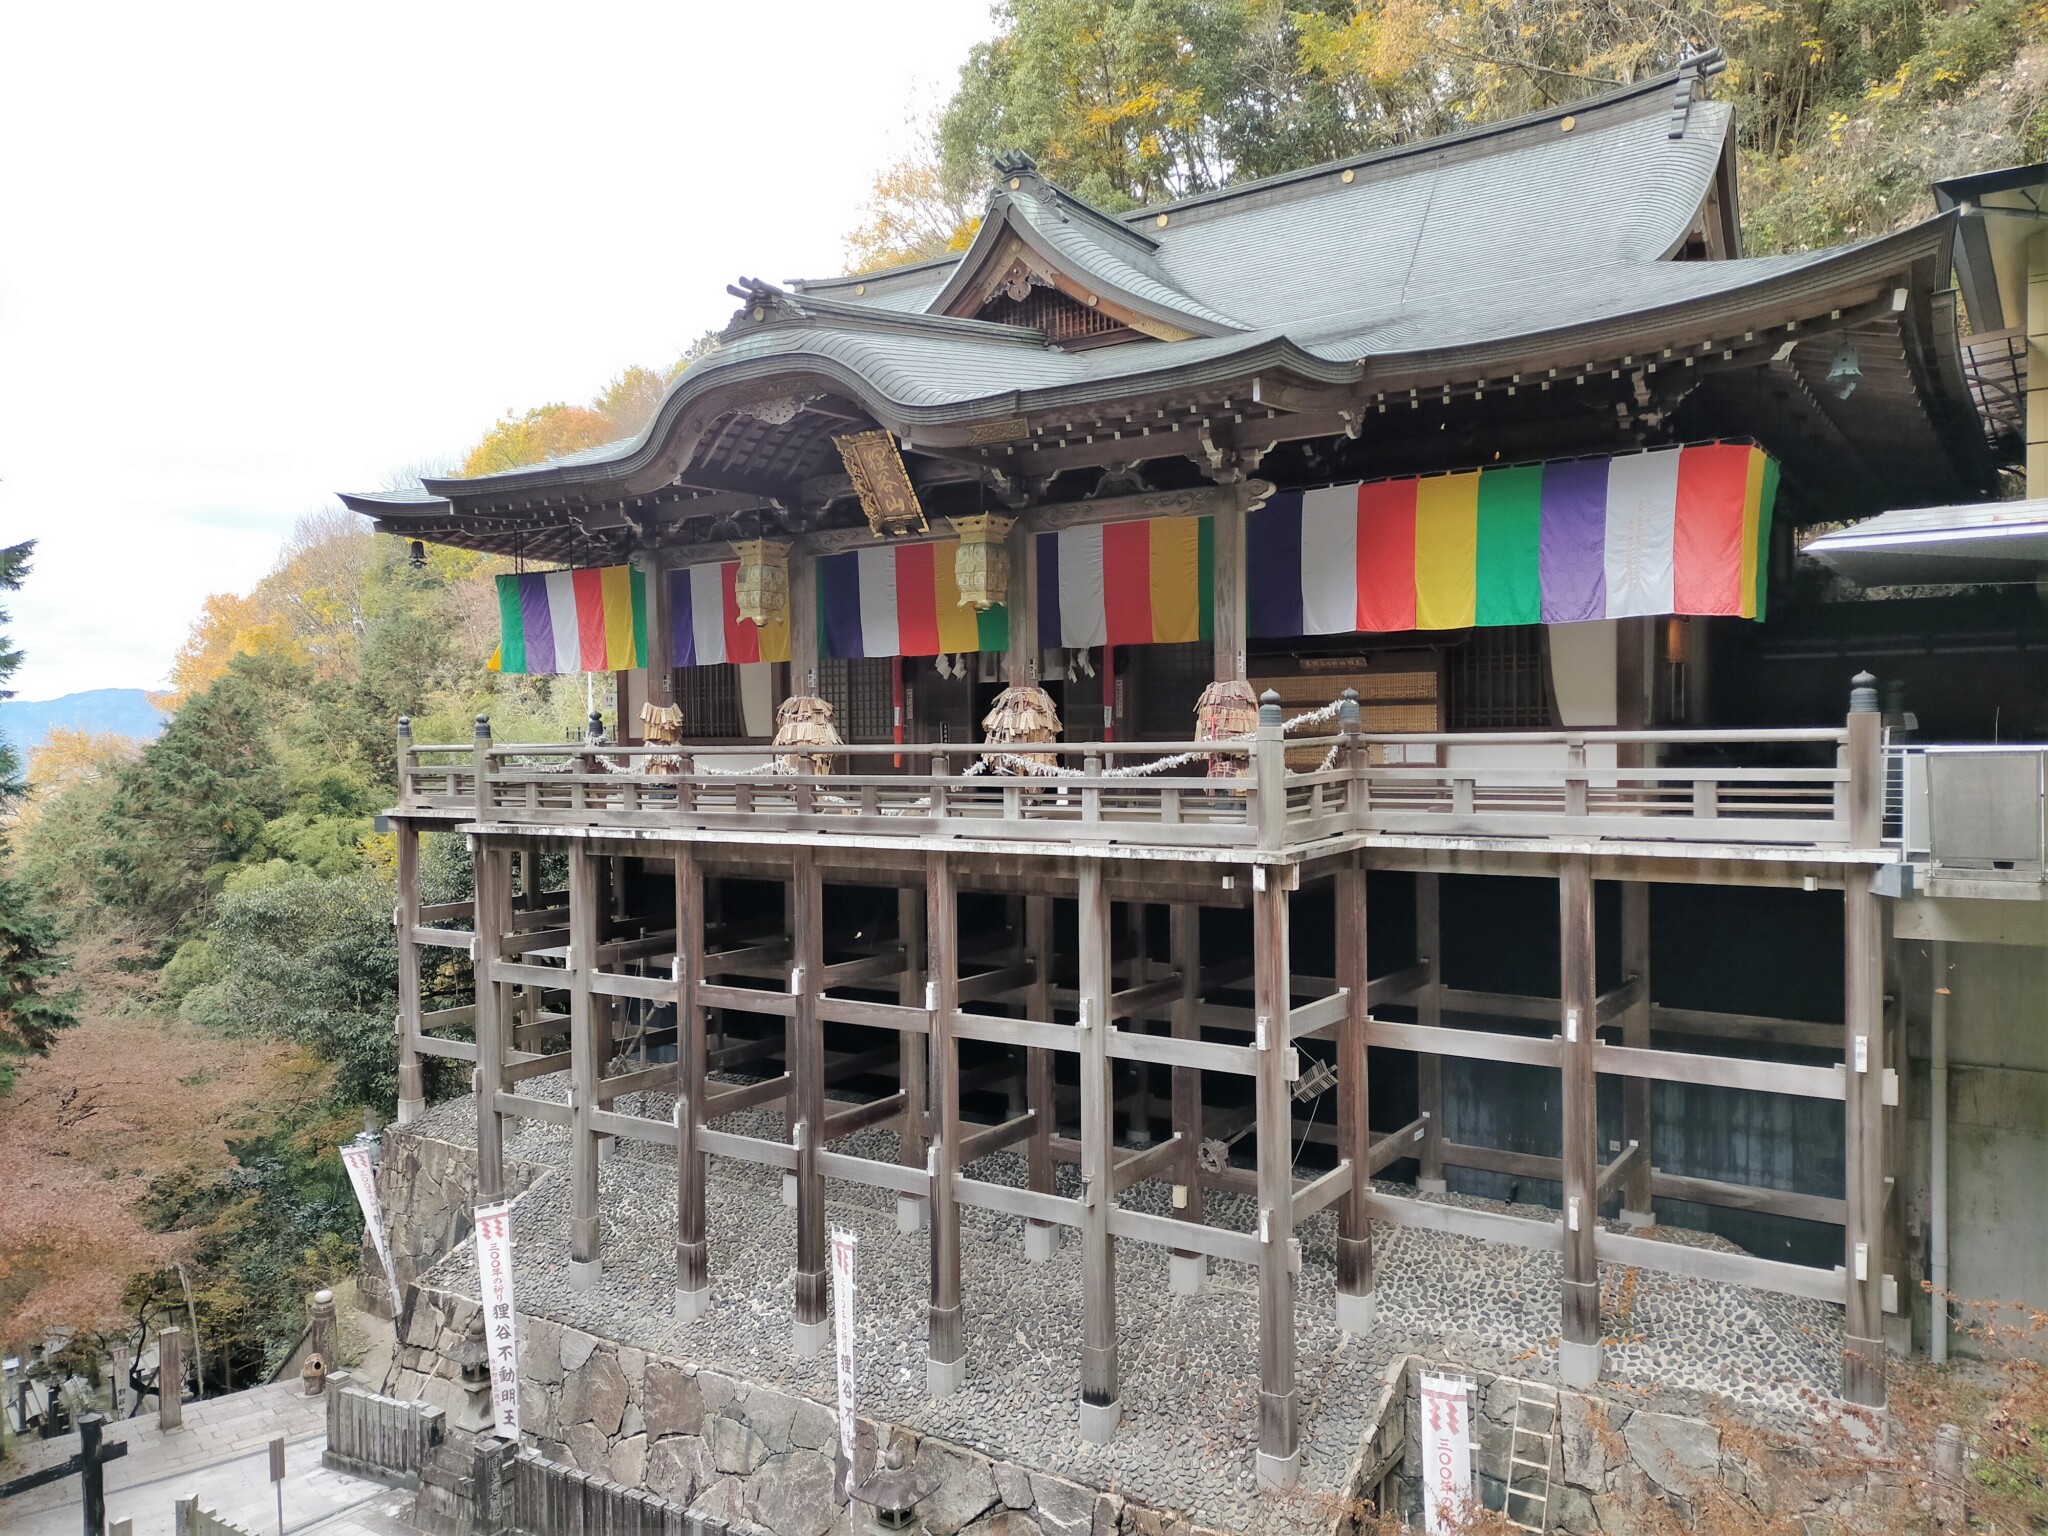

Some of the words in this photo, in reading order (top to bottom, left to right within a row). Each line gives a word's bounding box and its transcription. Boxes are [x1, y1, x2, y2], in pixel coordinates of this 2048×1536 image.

[492, 1302, 517, 1428] 狸谷不動明王
